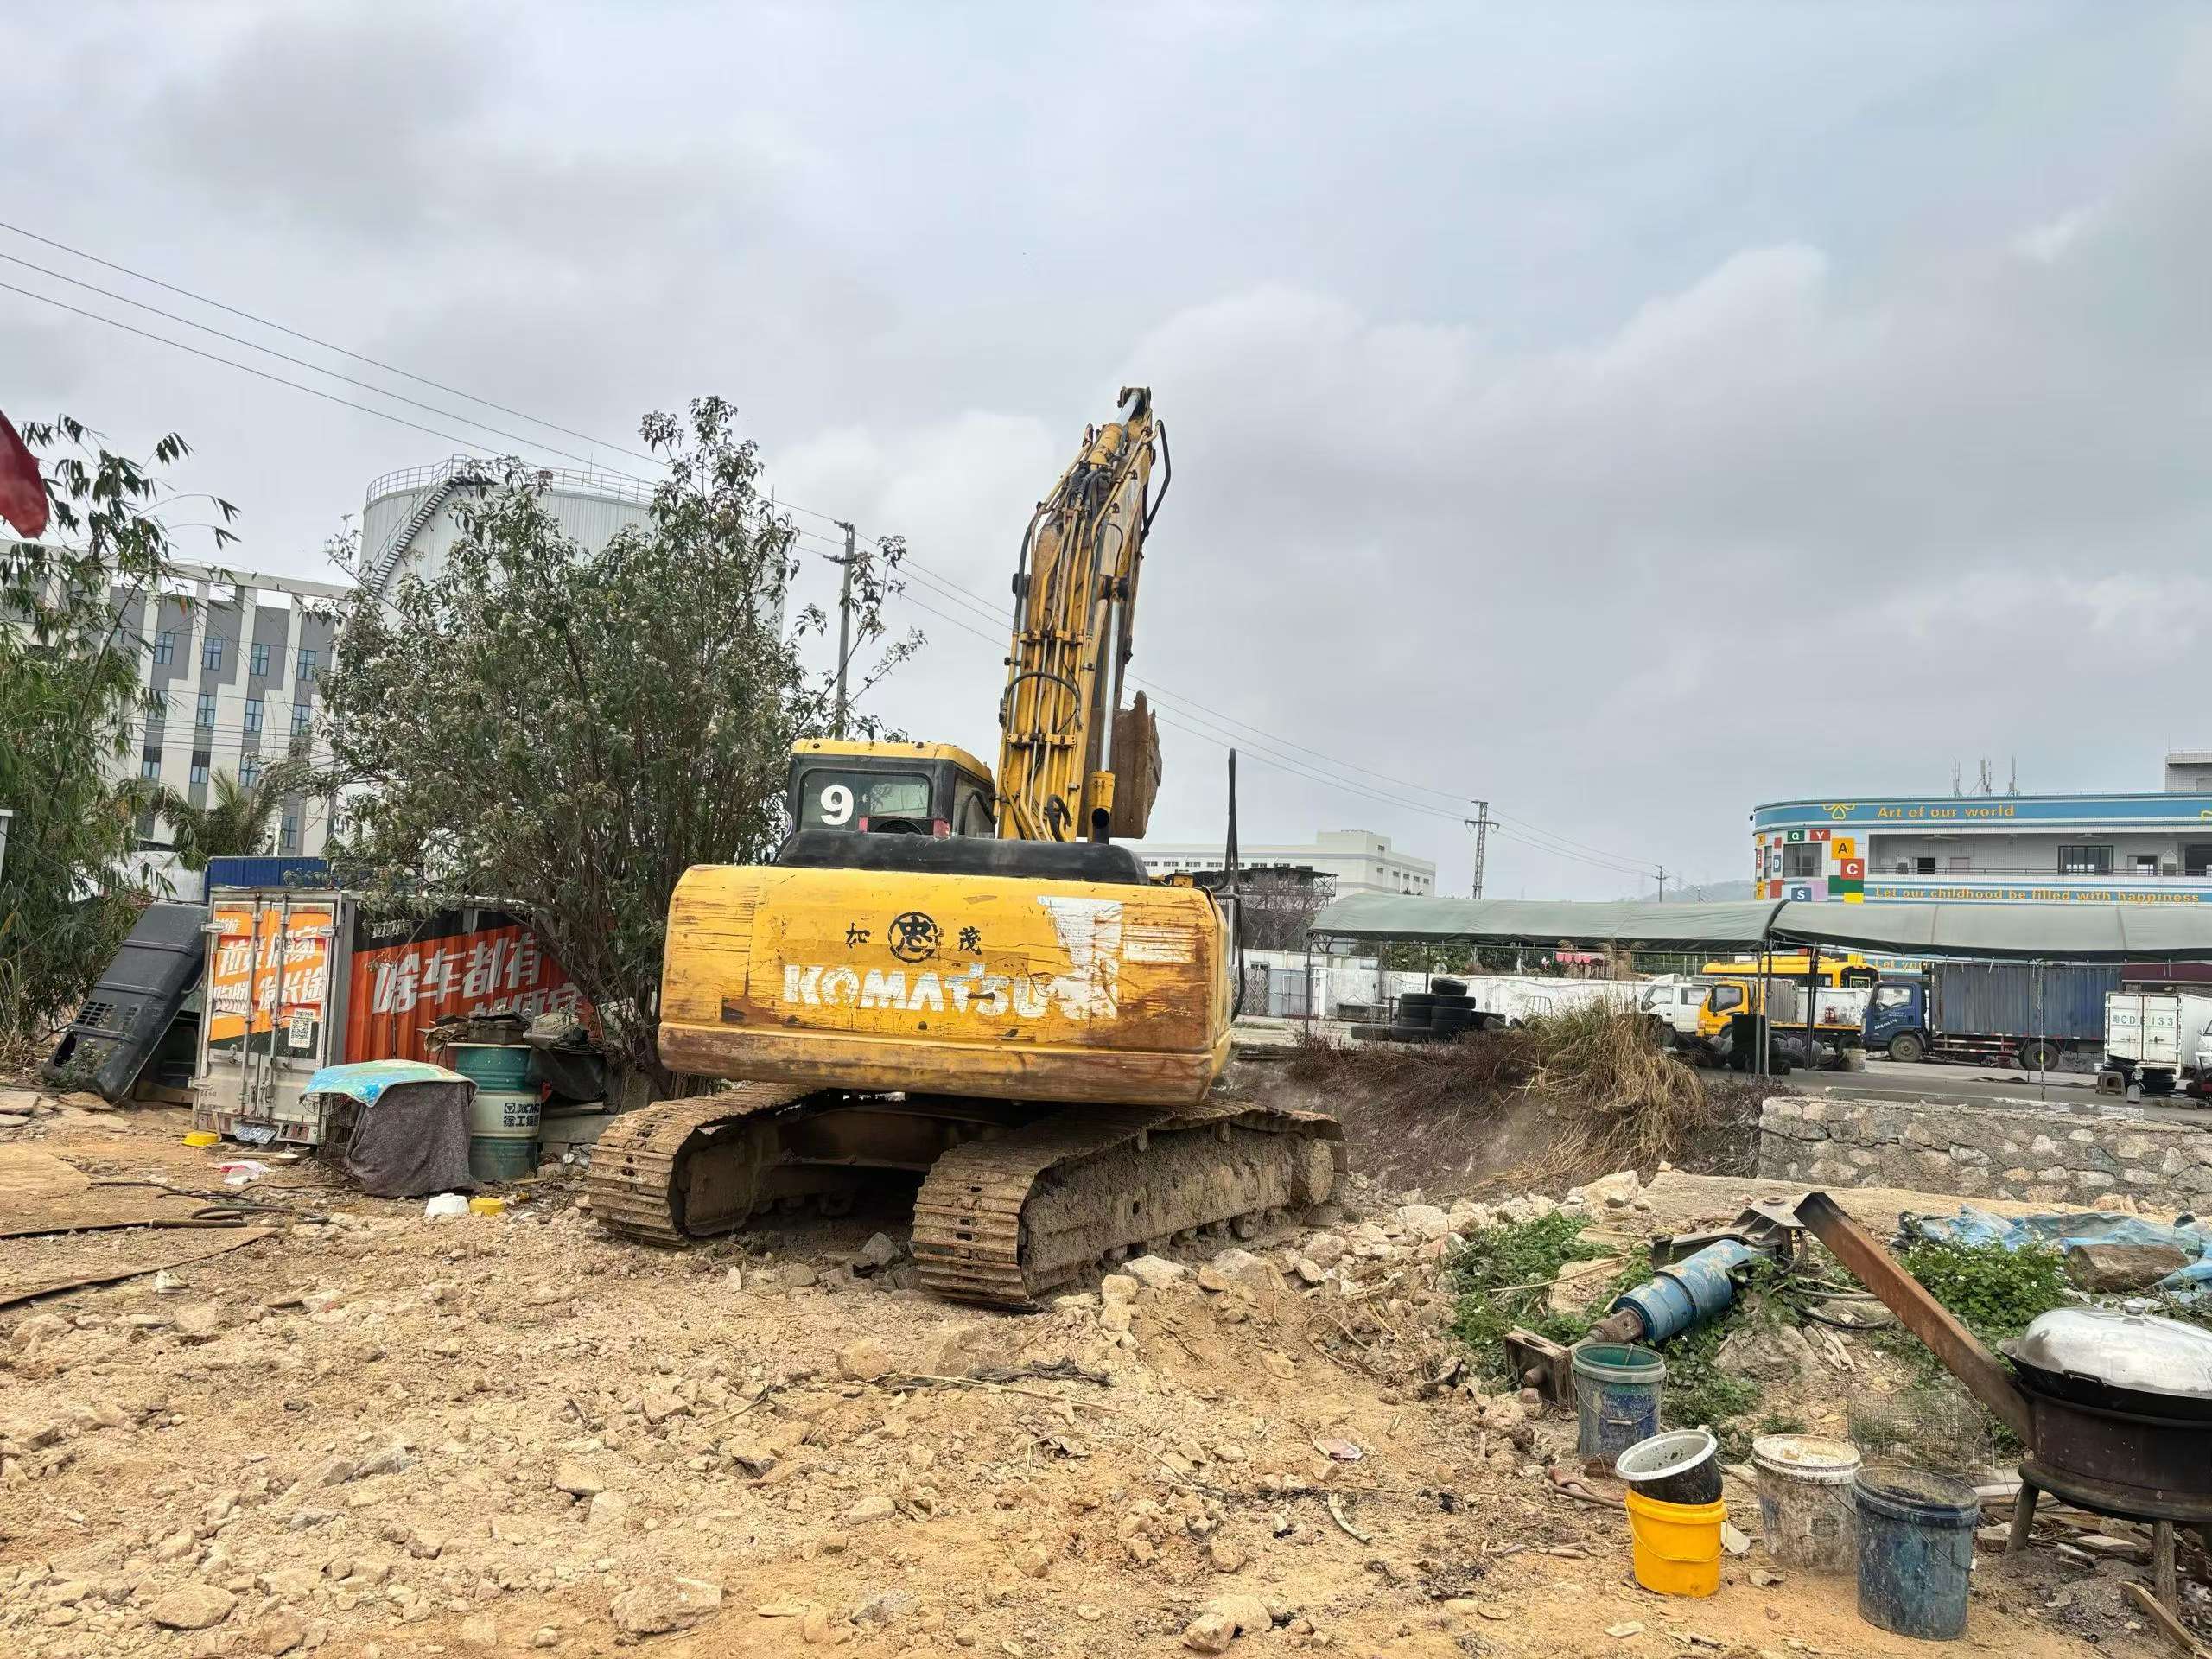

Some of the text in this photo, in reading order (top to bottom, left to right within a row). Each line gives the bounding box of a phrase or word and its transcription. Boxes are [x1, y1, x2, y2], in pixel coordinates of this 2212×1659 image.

[821, 785, 854, 826] 9
[1878, 804, 2015, 818] Art of our world
[1791, 832, 1800, 841] Q
[1838, 842, 1848, 854] A
[1774, 859, 1780, 868] D
[1847, 863, 1859, 875] C
[1796, 889, 1806, 899] S
[1875, 886, 2200, 904] Let our childhood be filled with happiness
[372, 931, 543, 1014] 啥车都有
[1901, 959, 1923, 973] yo
[783, 963, 1048, 1019] KOMATSU
